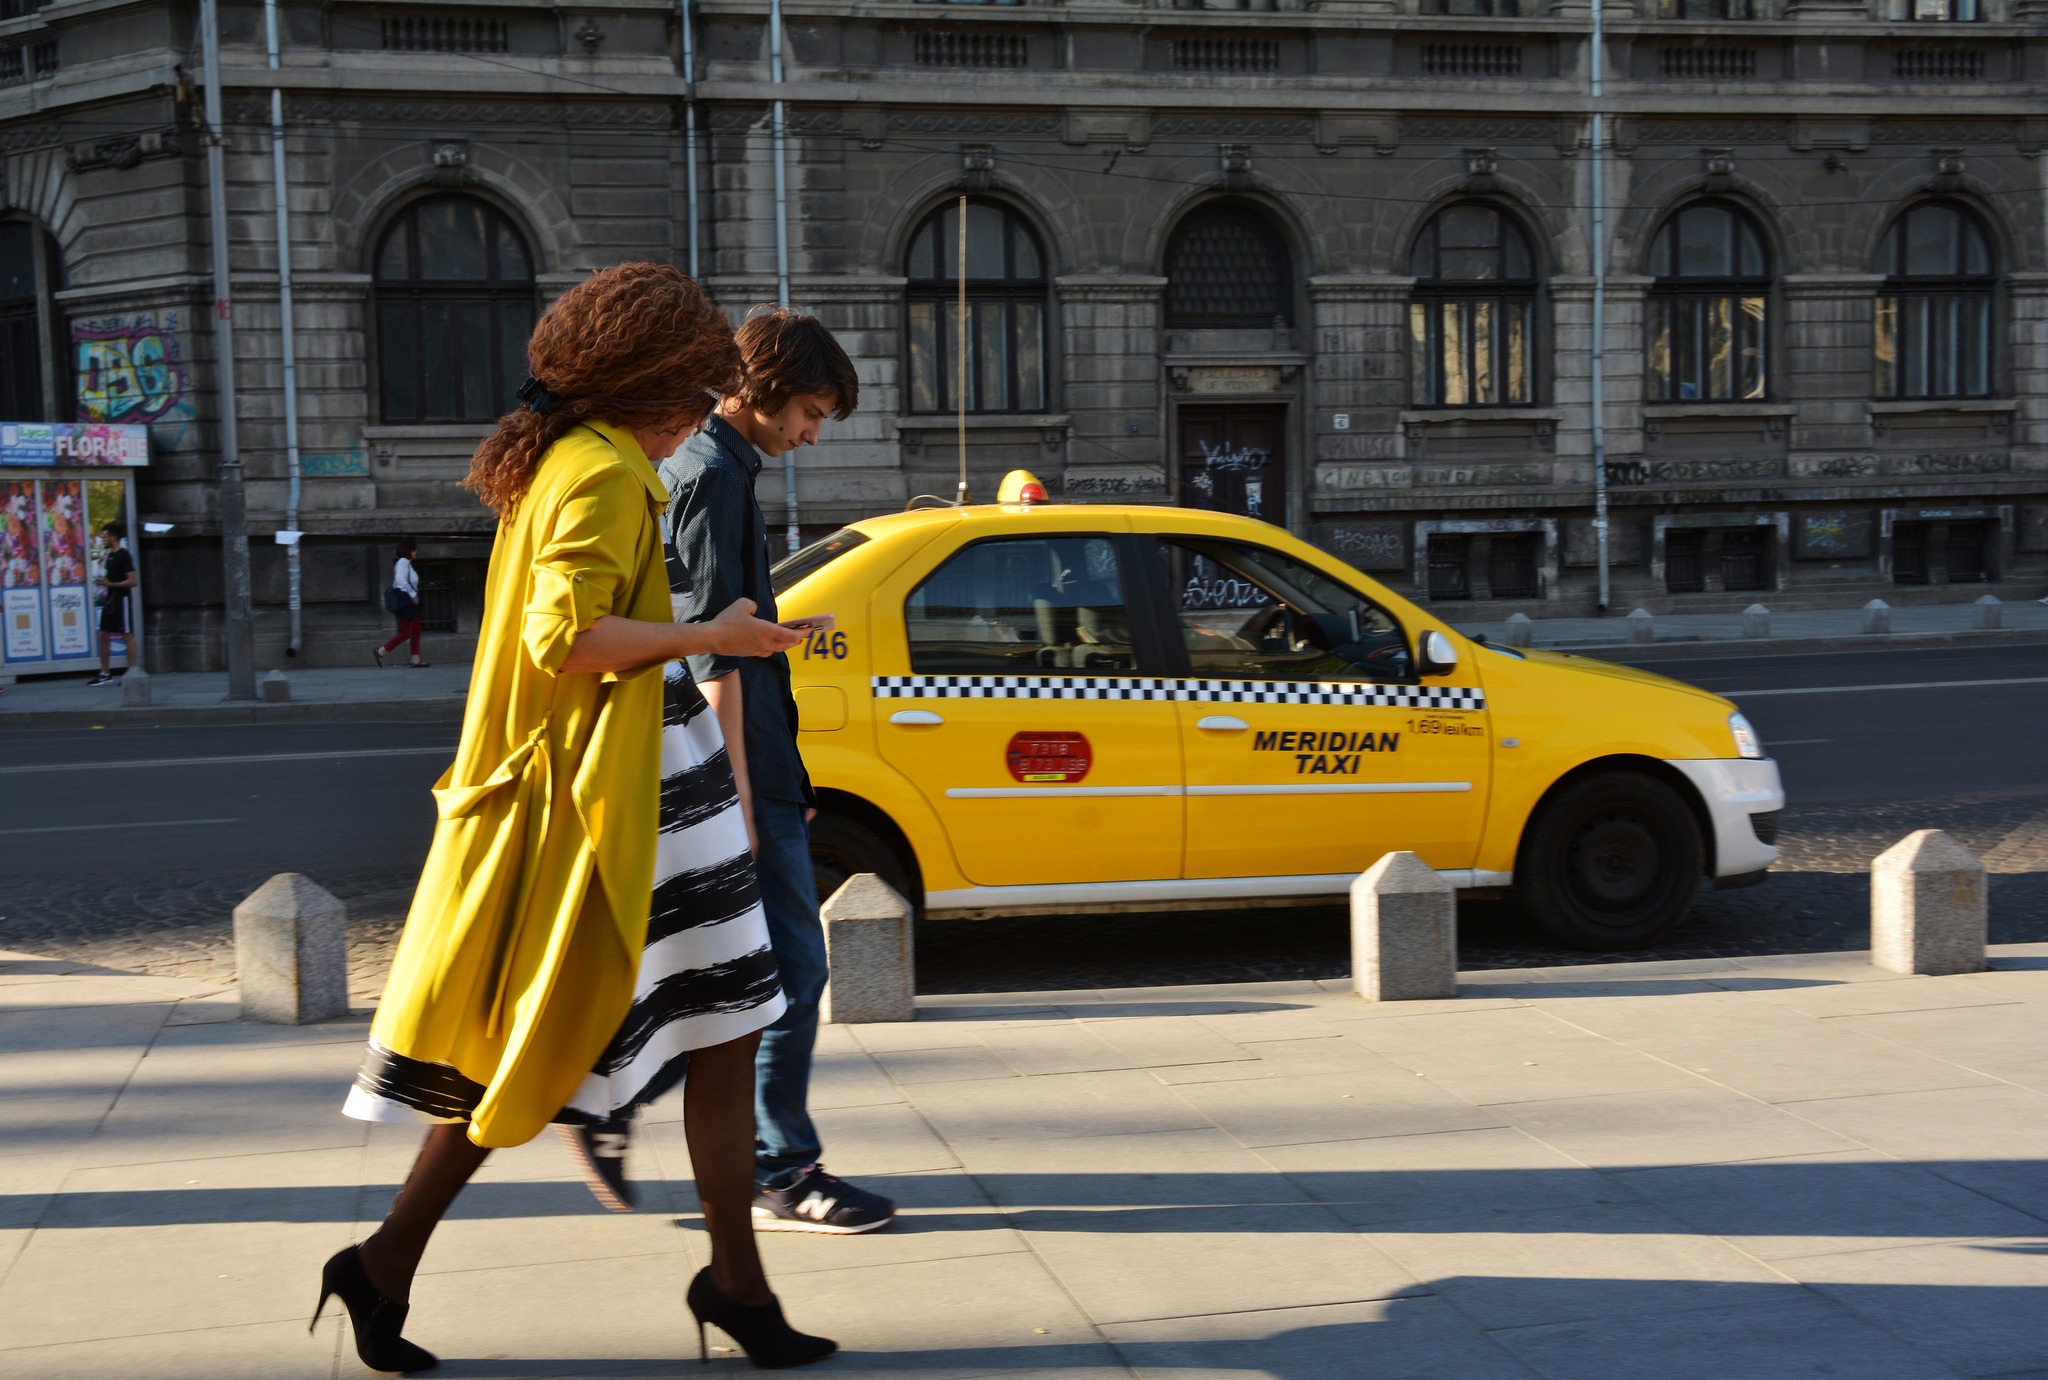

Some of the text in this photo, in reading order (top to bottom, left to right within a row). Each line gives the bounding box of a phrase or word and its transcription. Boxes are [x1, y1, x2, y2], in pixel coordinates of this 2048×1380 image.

[55, 436, 148, 457] FLORARIE
[1253, 731, 1400, 753] MERIDIAN
[1296, 753, 1362, 775] TAXI
[795, 1190, 838, 1221] N
